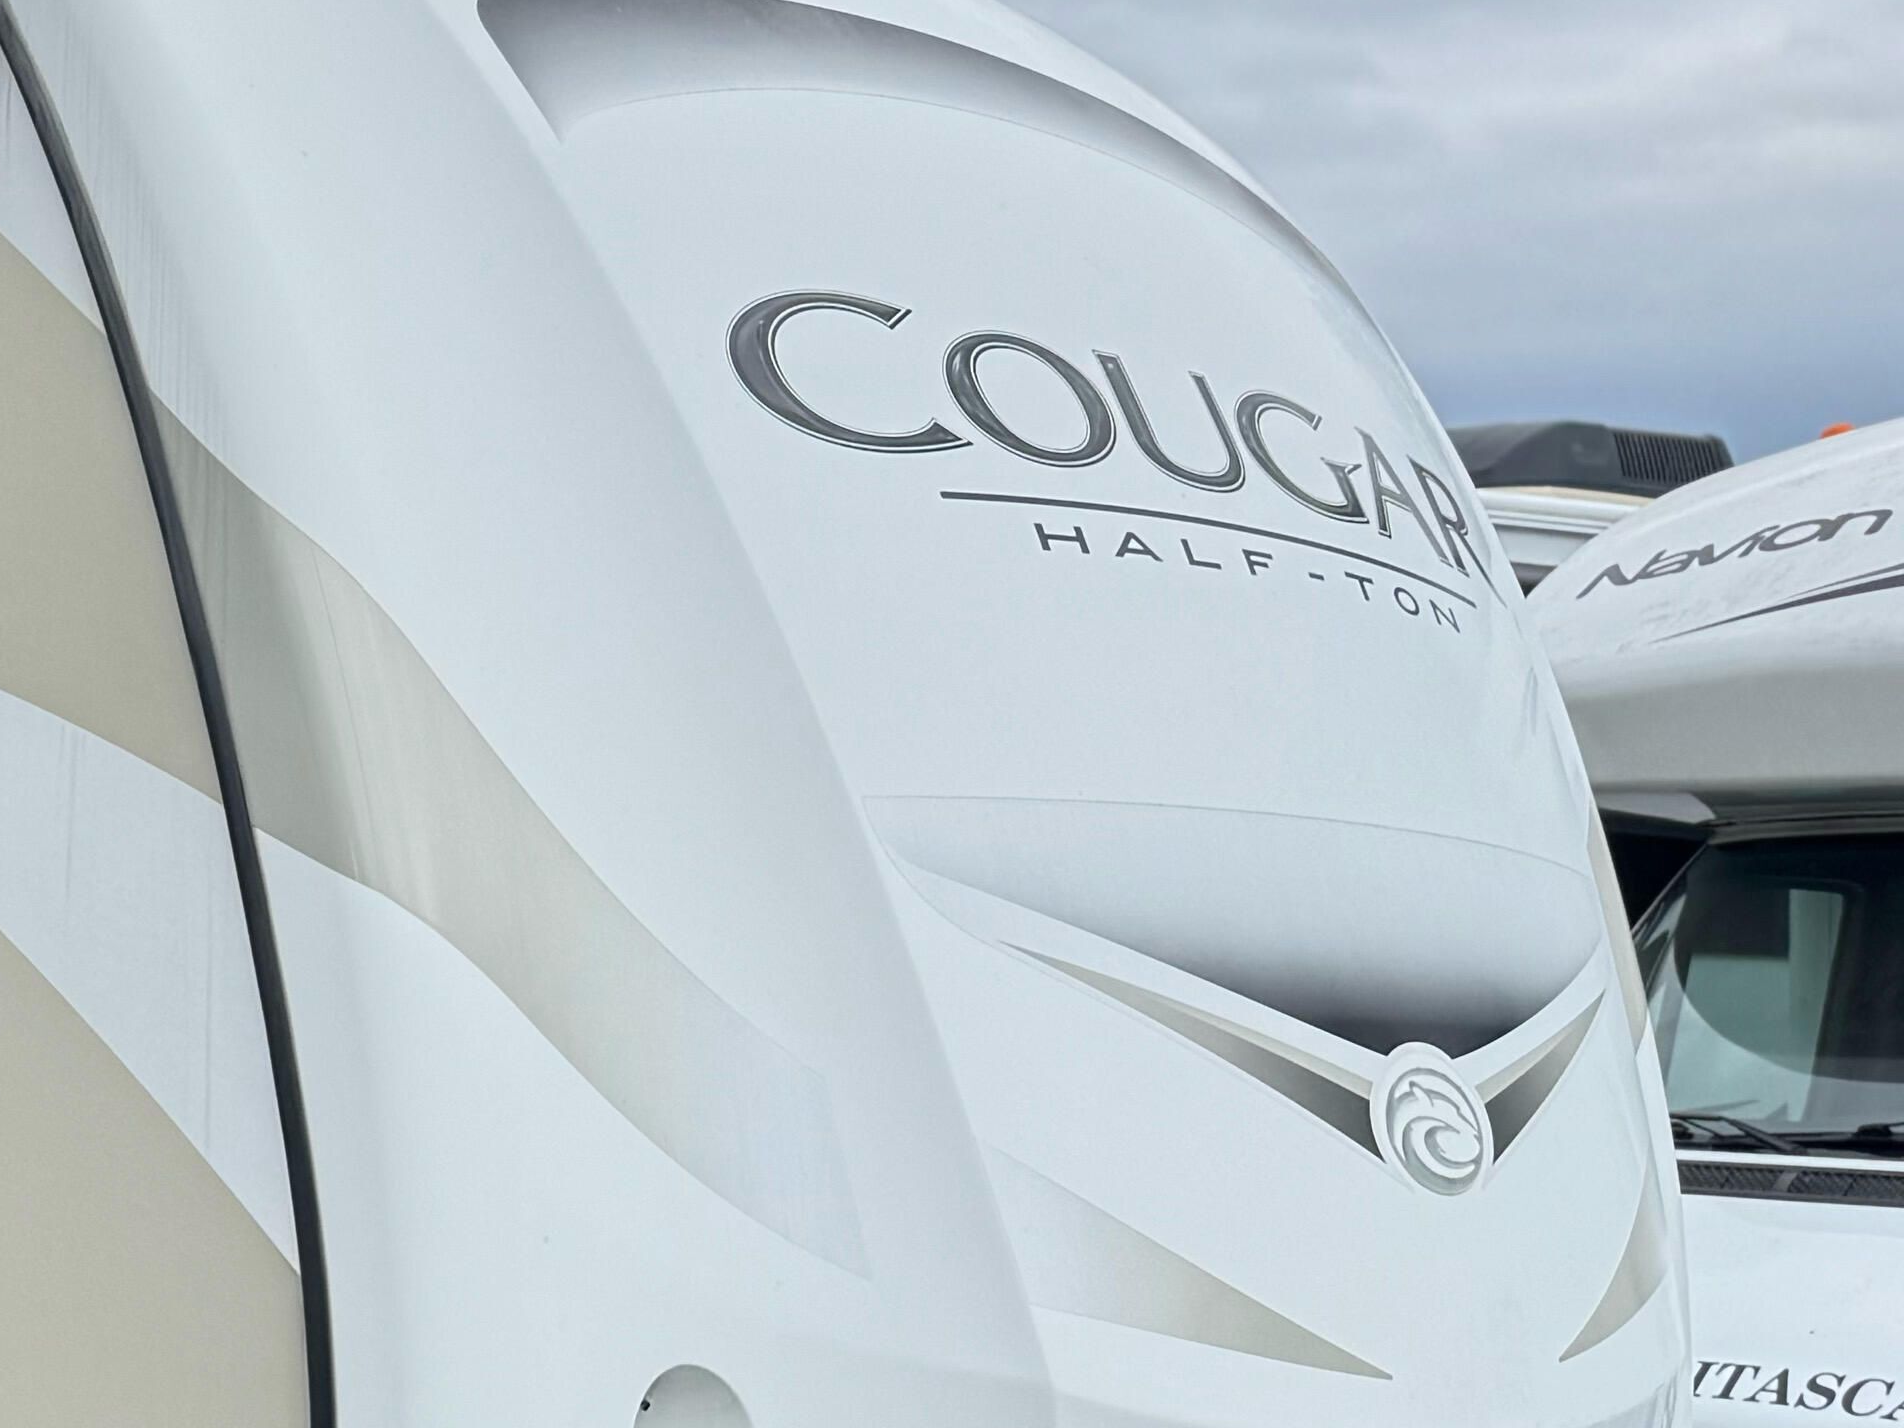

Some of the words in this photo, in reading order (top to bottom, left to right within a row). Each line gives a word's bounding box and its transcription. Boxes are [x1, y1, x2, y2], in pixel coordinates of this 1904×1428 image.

[725, 289, 1508, 608] COUGAR
[1033, 522, 1462, 634] HALF-TON
[1575, 508, 1894, 600] Navion
